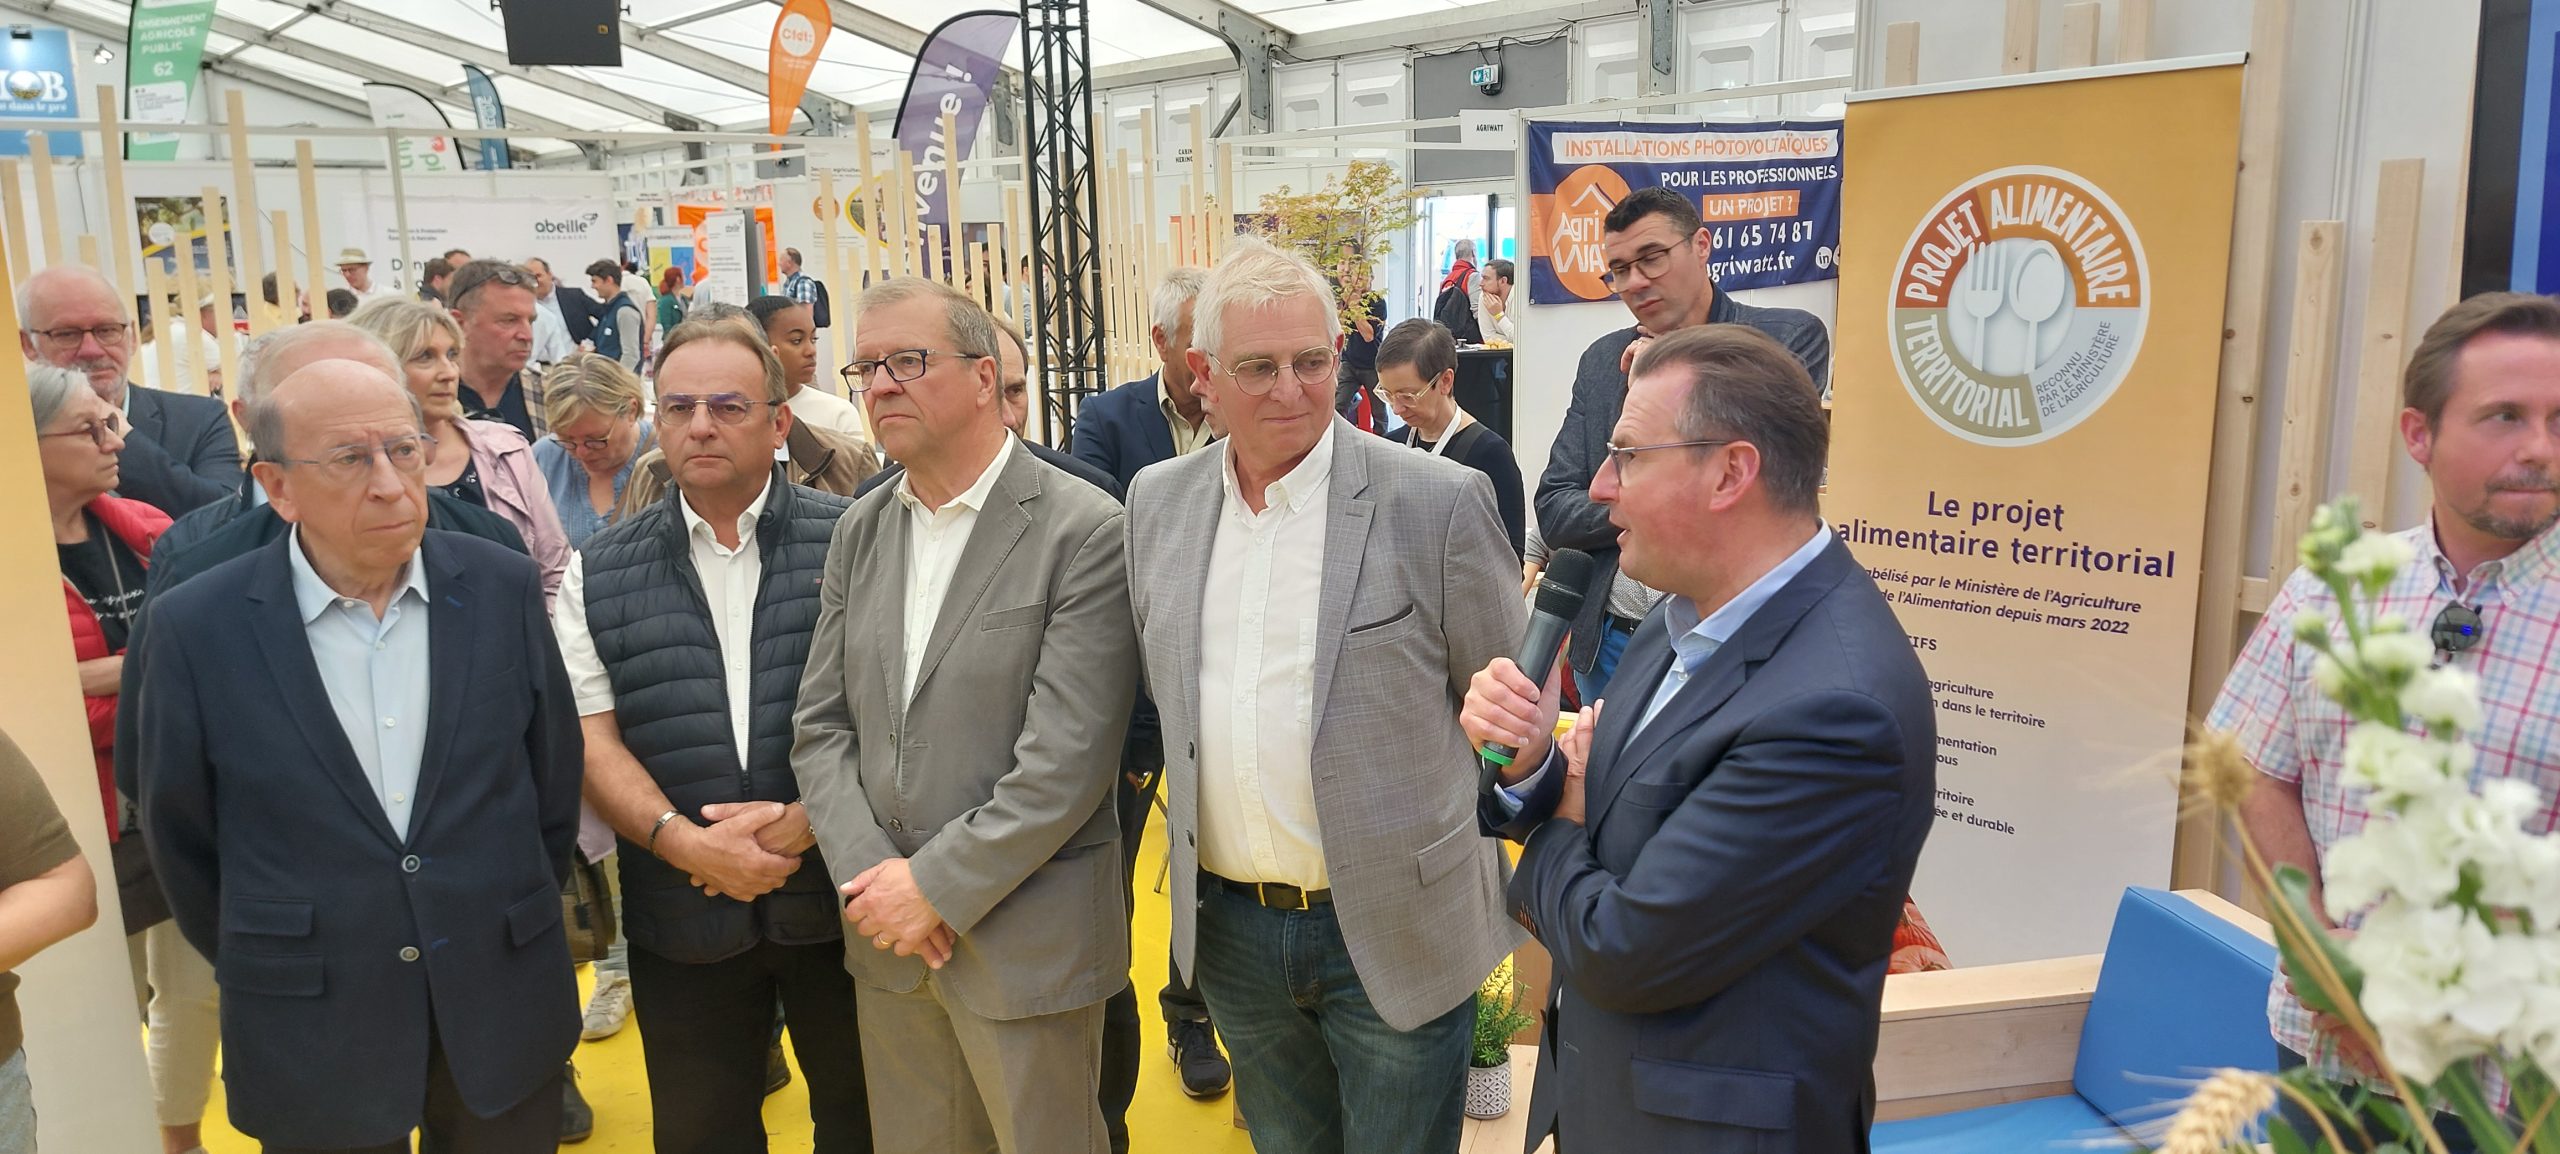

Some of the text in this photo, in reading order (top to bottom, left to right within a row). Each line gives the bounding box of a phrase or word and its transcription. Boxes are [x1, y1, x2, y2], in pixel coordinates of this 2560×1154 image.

[140, 26, 197, 41] AGRICOLE
[142, 41, 183, 54] PUBLIC
[153, 61, 174, 76] 62
[1565, 133, 1828, 157] INSTALLATIONS PHOTOVOLTAÏQUES
[1661, 165, 1838, 187] POUR LES PROFESSIONNELS
[1709, 195, 1793, 216] UN PROJET ?
[535, 219, 588, 233] abeille
[1553, 210, 1599, 246] Agri
[1713, 221, 1813, 249] 61 65 74 87
[1905, 184, 2130, 303] PROJET ALIMENTAIRE
[1554, 243, 1606, 273] WA
[1904, 314, 2030, 428] TERRITORIAL
[2035, 351, 2083, 395] RECONNU
[2039, 321, 2111, 406] PAR LE MINISTÈRE
[2042, 334, 2120, 417] DE L'AGRICULTURE
[1928, 491, 2064, 532] Le projet
[1838, 518, 2175, 578] alimentaire territorial
[1911, 575, 1936, 588] par
[1939, 576, 1952, 589] le
[1955, 578, 2019, 598] Ministère
[2023, 587, 2040, 601] de
[2044, 589, 2142, 613] l'Agriculture
[1898, 591, 1992, 616] l'Alimentation
[1995, 605, 2042, 623] depuis
[2046, 614, 2086, 629] mars
[2090, 617, 2130, 634] 2022
[1942, 699, 1972, 714] dans
[1975, 704, 1986, 717] le
[1990, 708, 2046, 728] territoire
[1936, 735, 1997, 756] mentation
[1936, 754, 1958, 766] ous
[1936, 788, 1975, 806] ritoire
[1952, 812, 1963, 822] et
[1967, 814, 2015, 834] durable
